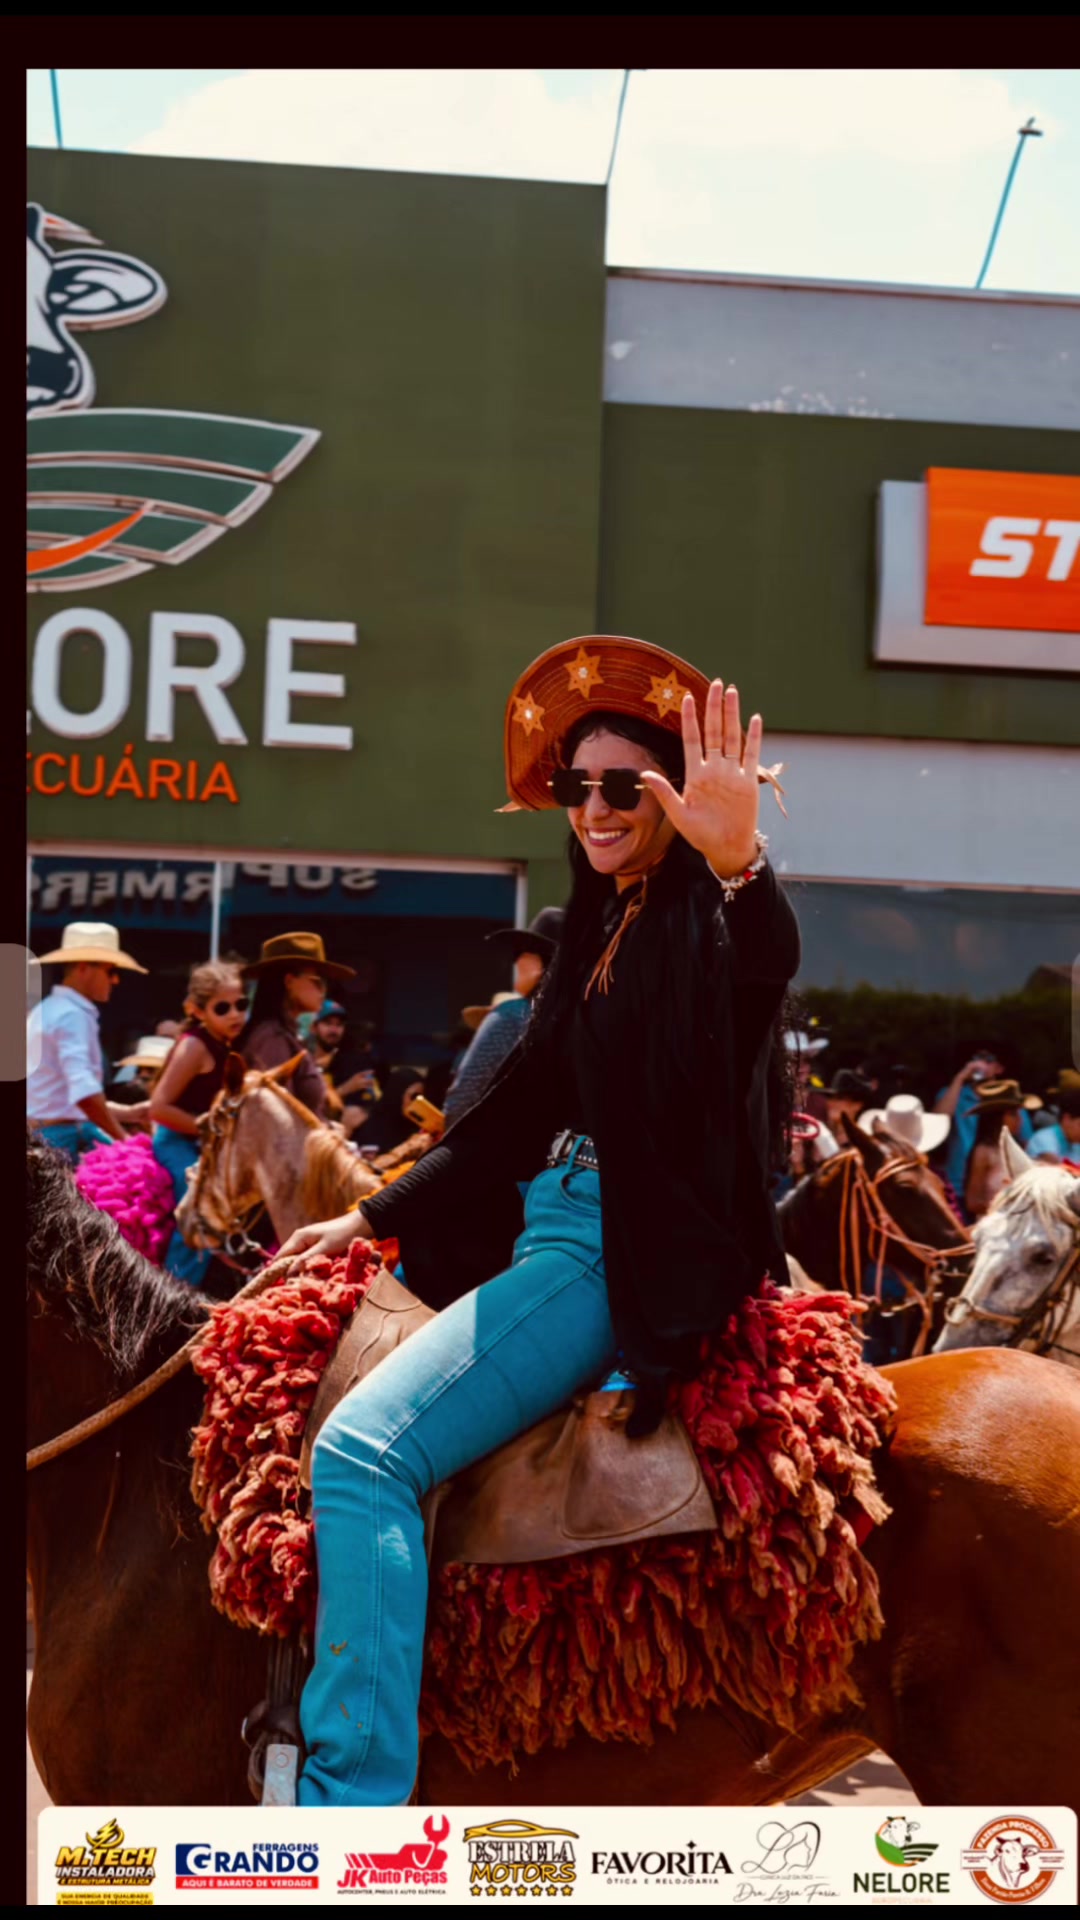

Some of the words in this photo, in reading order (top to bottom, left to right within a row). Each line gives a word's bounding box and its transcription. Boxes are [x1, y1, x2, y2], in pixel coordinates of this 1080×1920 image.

[968, 515, 1080, 582] ST
[26, 607, 357, 750] ORE
[26, 743, 240, 803] CUÁRIA
